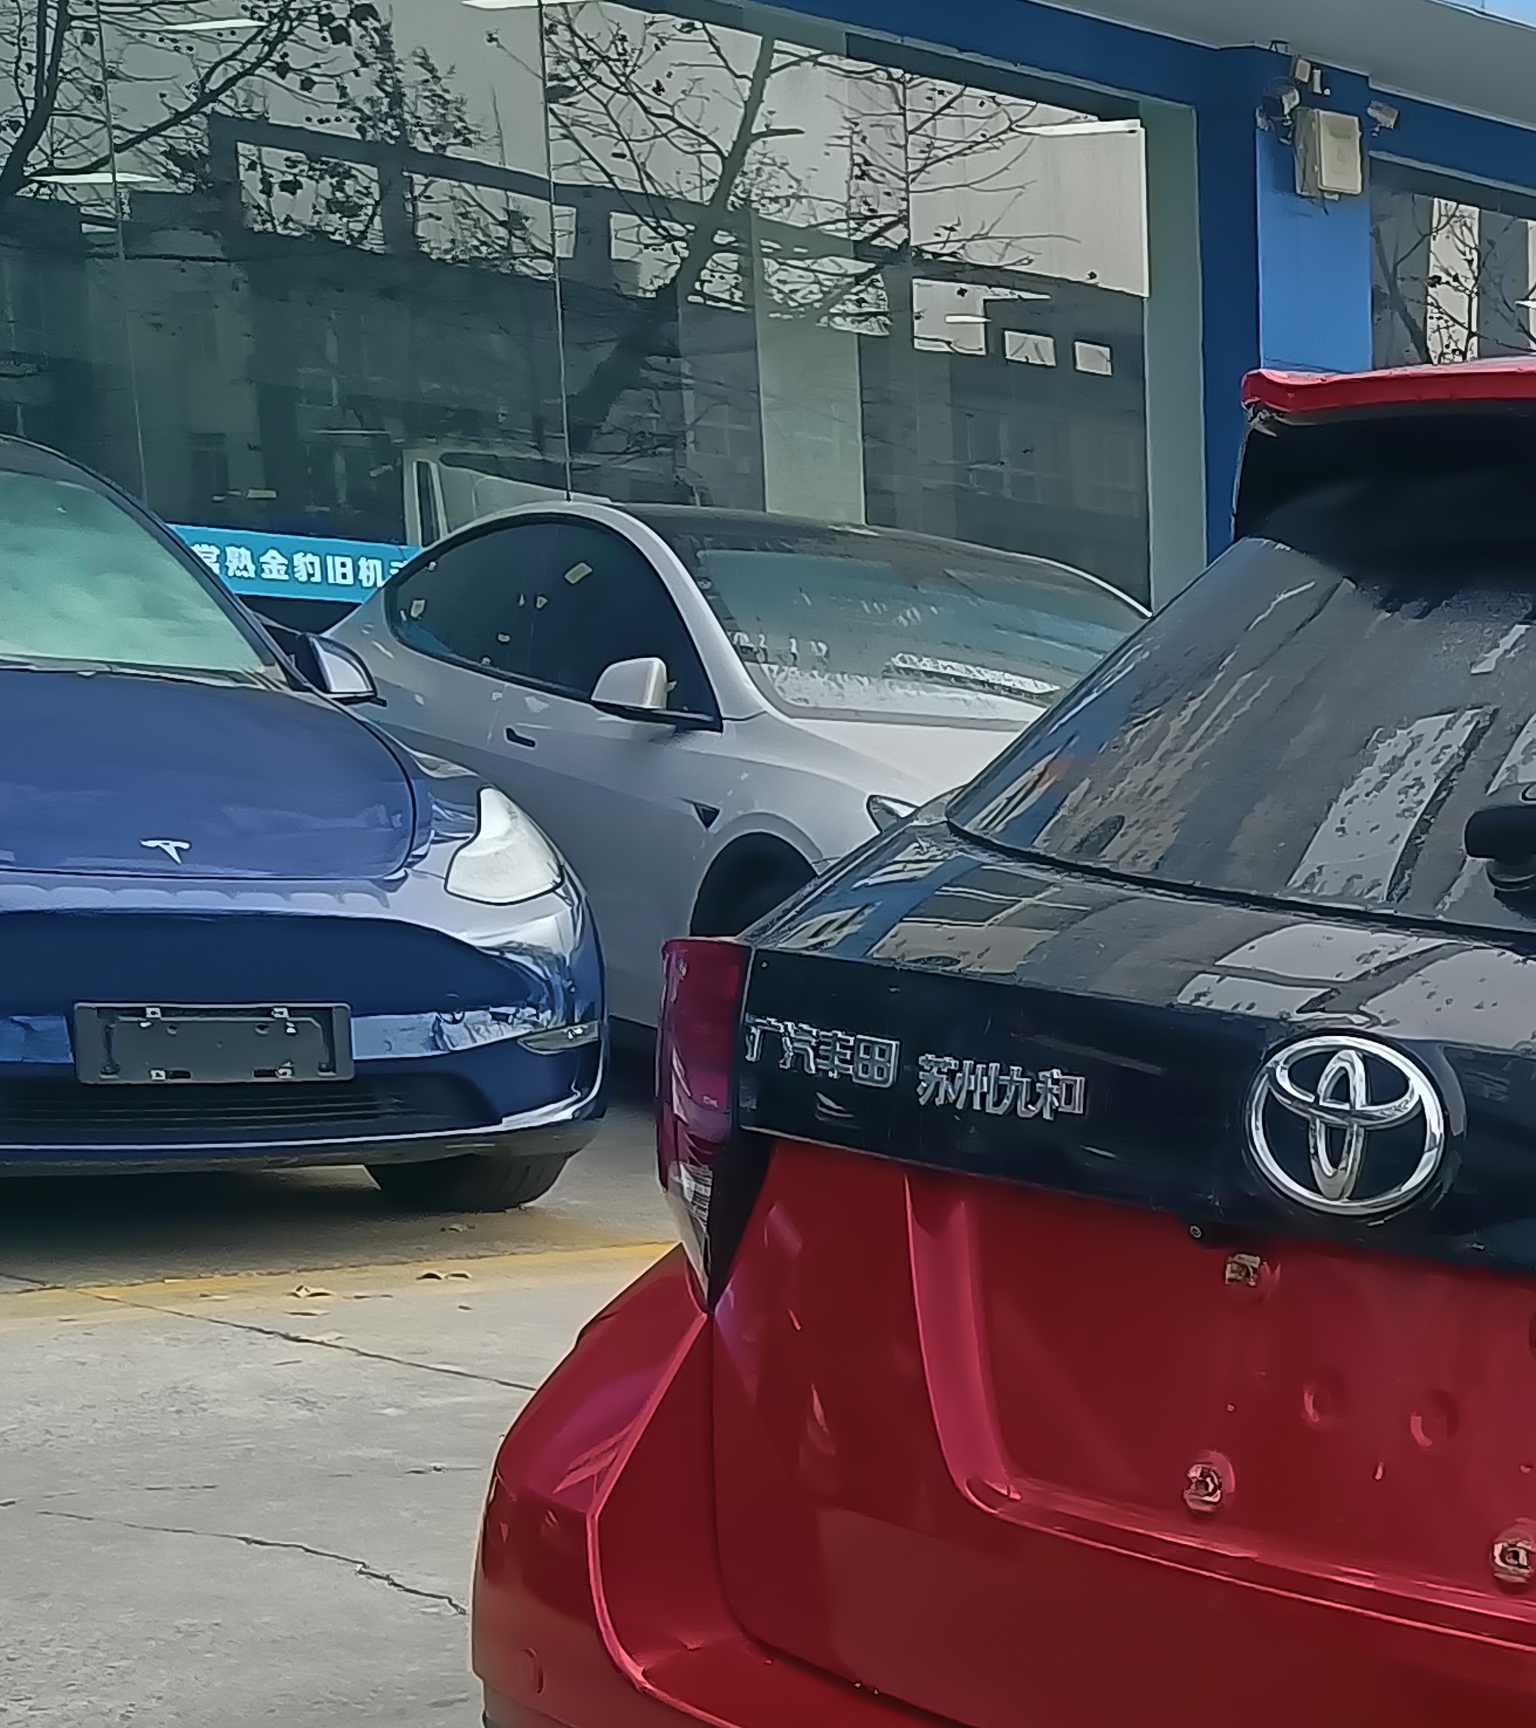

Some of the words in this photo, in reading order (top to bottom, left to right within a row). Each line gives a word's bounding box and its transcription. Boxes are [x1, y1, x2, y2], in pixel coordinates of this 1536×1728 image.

[190, 543, 404, 588] 常熟金豹旧机
[744, 1011, 900, 1090] 广汽丰田
[916, 1053, 1088, 1122] 苏州九和
